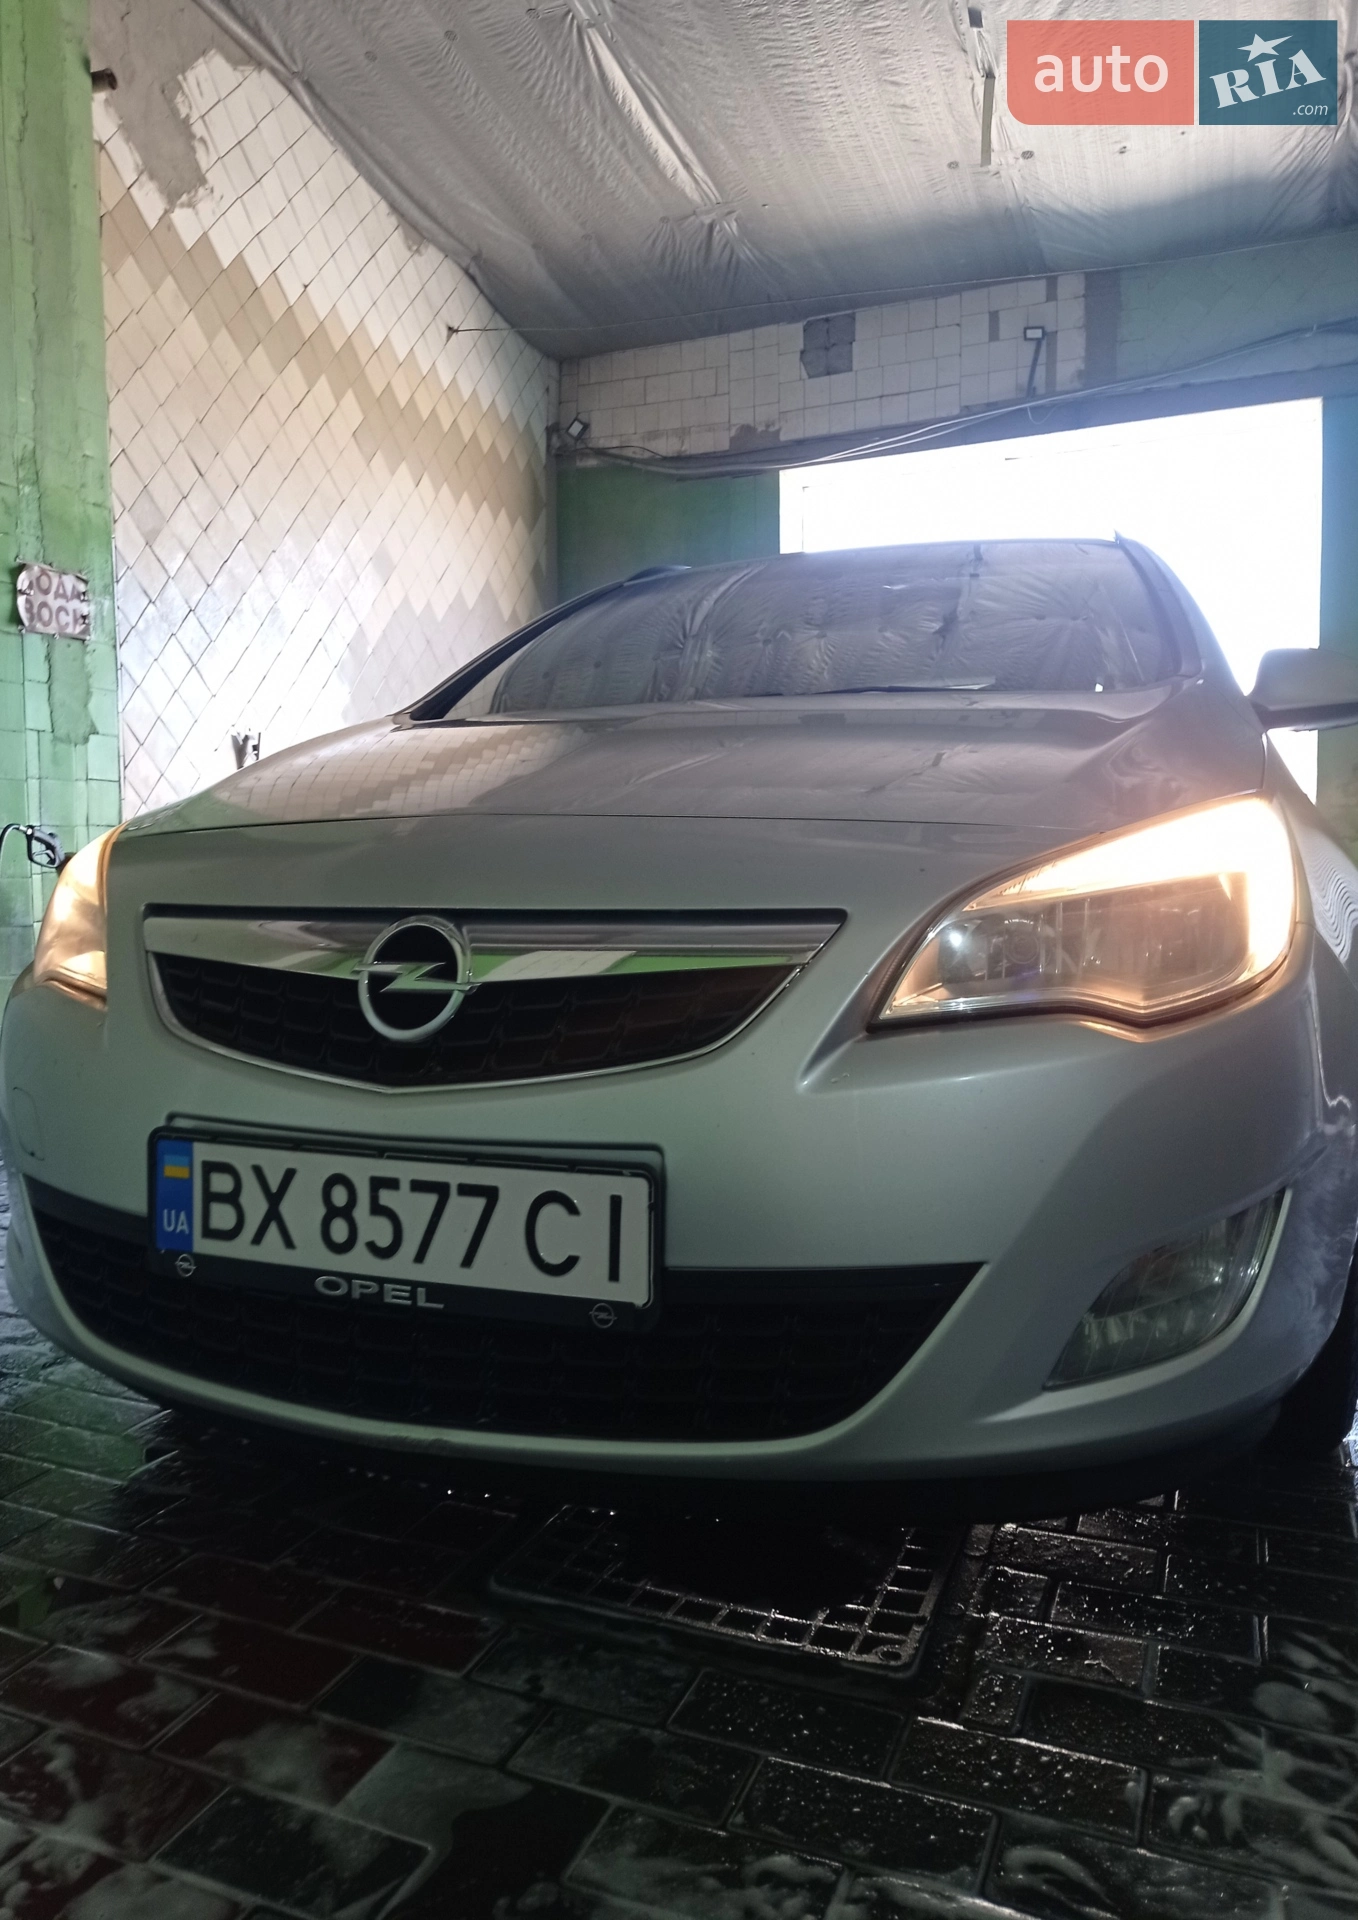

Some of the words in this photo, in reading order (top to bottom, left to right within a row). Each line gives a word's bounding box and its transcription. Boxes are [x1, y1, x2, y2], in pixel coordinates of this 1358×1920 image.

[163, 1208, 190, 1235] UA
[201, 1160, 297, 1250] BX
[320, 1173, 499, 1269] 8577
[525, 1190, 622, 1283] CI
[314, 1275, 445, 1309] OPEL
